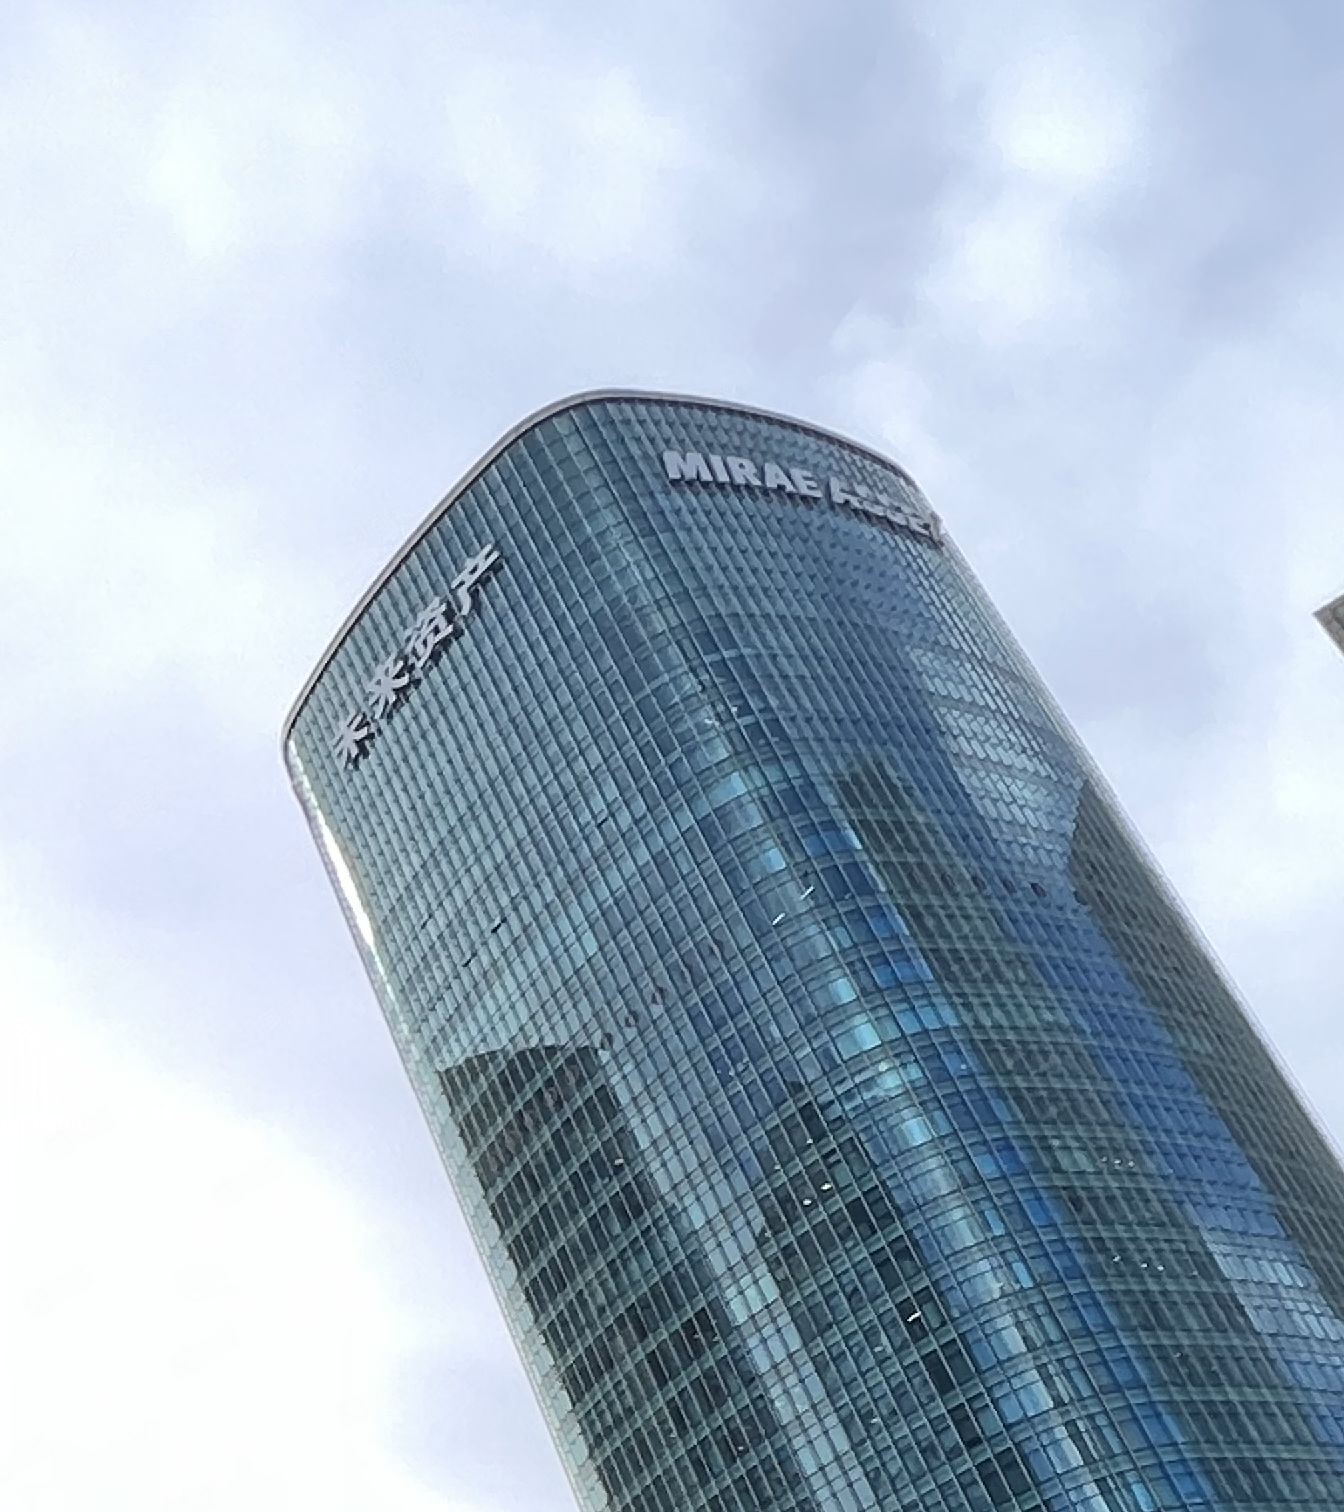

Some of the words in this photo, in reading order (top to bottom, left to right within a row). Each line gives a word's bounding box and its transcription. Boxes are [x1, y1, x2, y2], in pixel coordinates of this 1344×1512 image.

[662, 451, 822, 499] MIRAE
[333, 543, 500, 769] 未来资产
